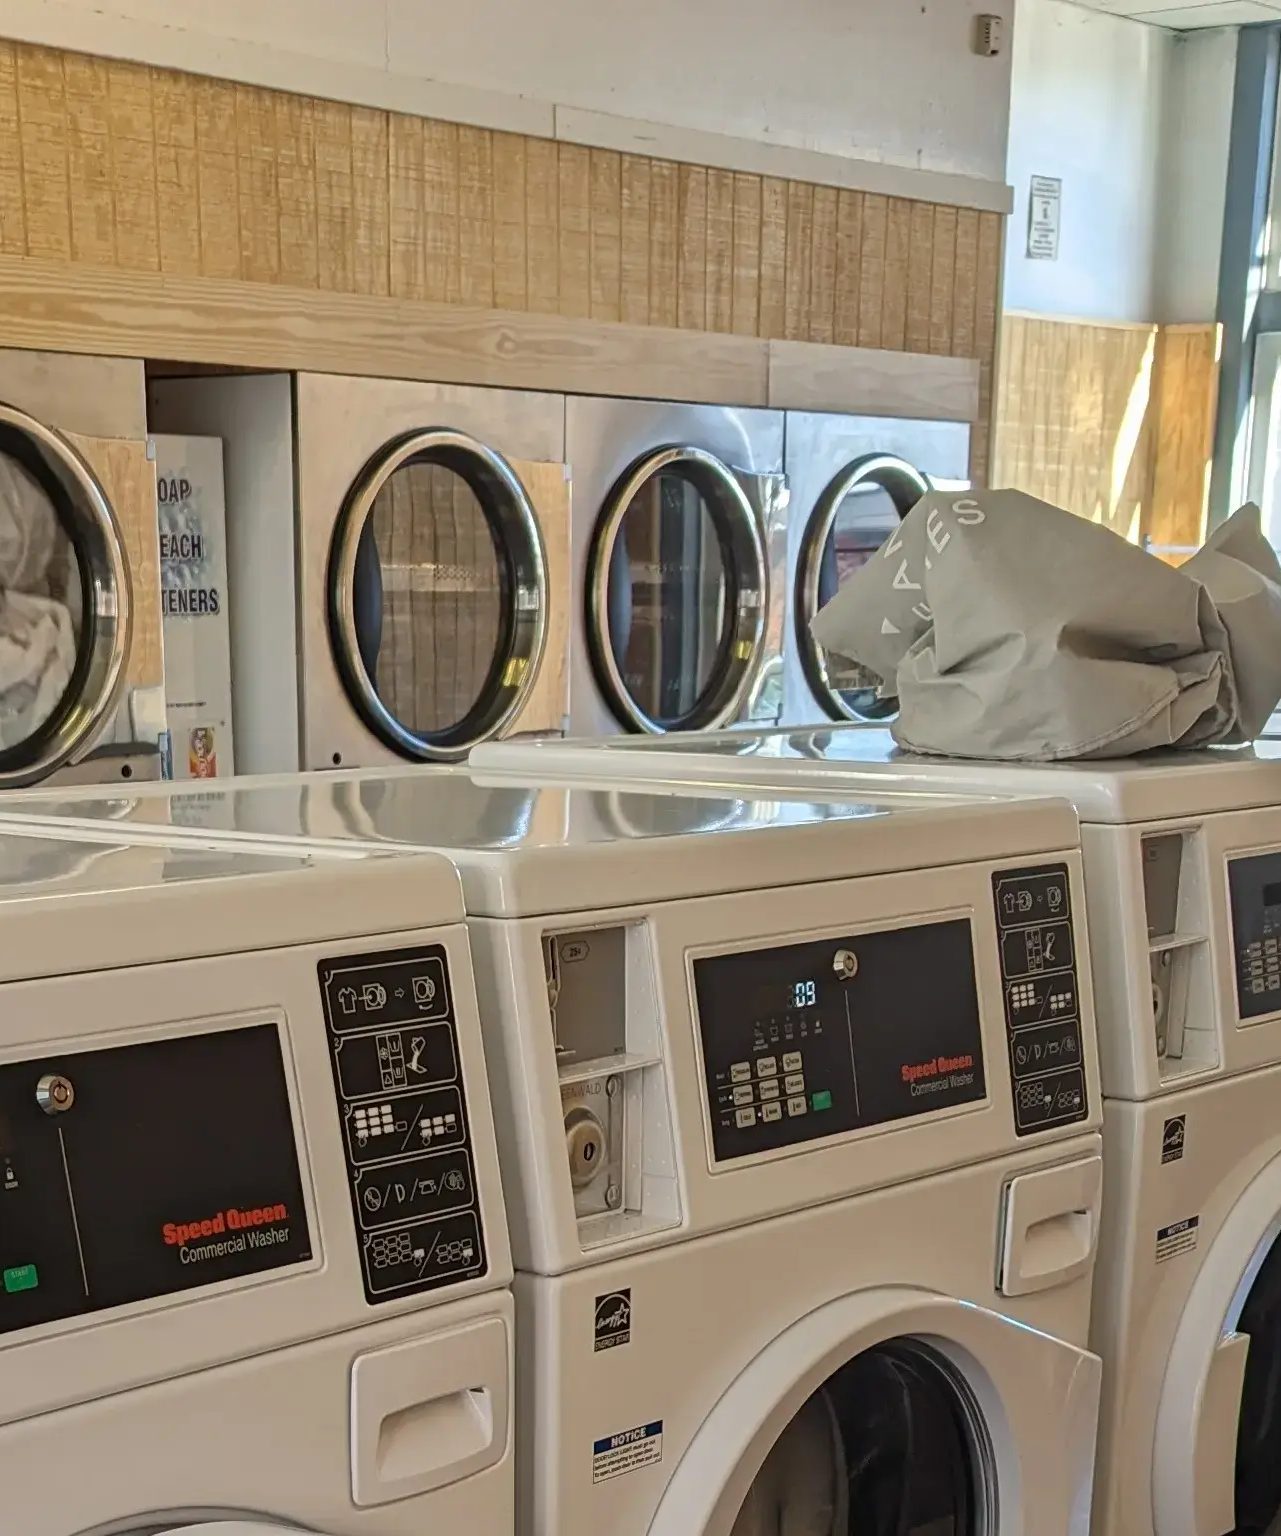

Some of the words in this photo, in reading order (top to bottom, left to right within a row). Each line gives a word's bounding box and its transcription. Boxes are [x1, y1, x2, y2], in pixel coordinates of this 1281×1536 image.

[158, 478, 191, 503] OAP
[159, 534, 203, 559] EACH
[161, 588, 219, 614] TENERS
[796, 981, 816, 1008] 09
[901, 1058, 937, 1083] Speed
[938, 1055, 974, 1073] Queen
[163, 1212, 225, 1246] Speed
[227, 1204, 287, 1229] Queen
[180, 1234, 246, 1264] Commercial
[247, 1228, 289, 1249] Washer
[611, 1427, 647, 1448] NOTICE
